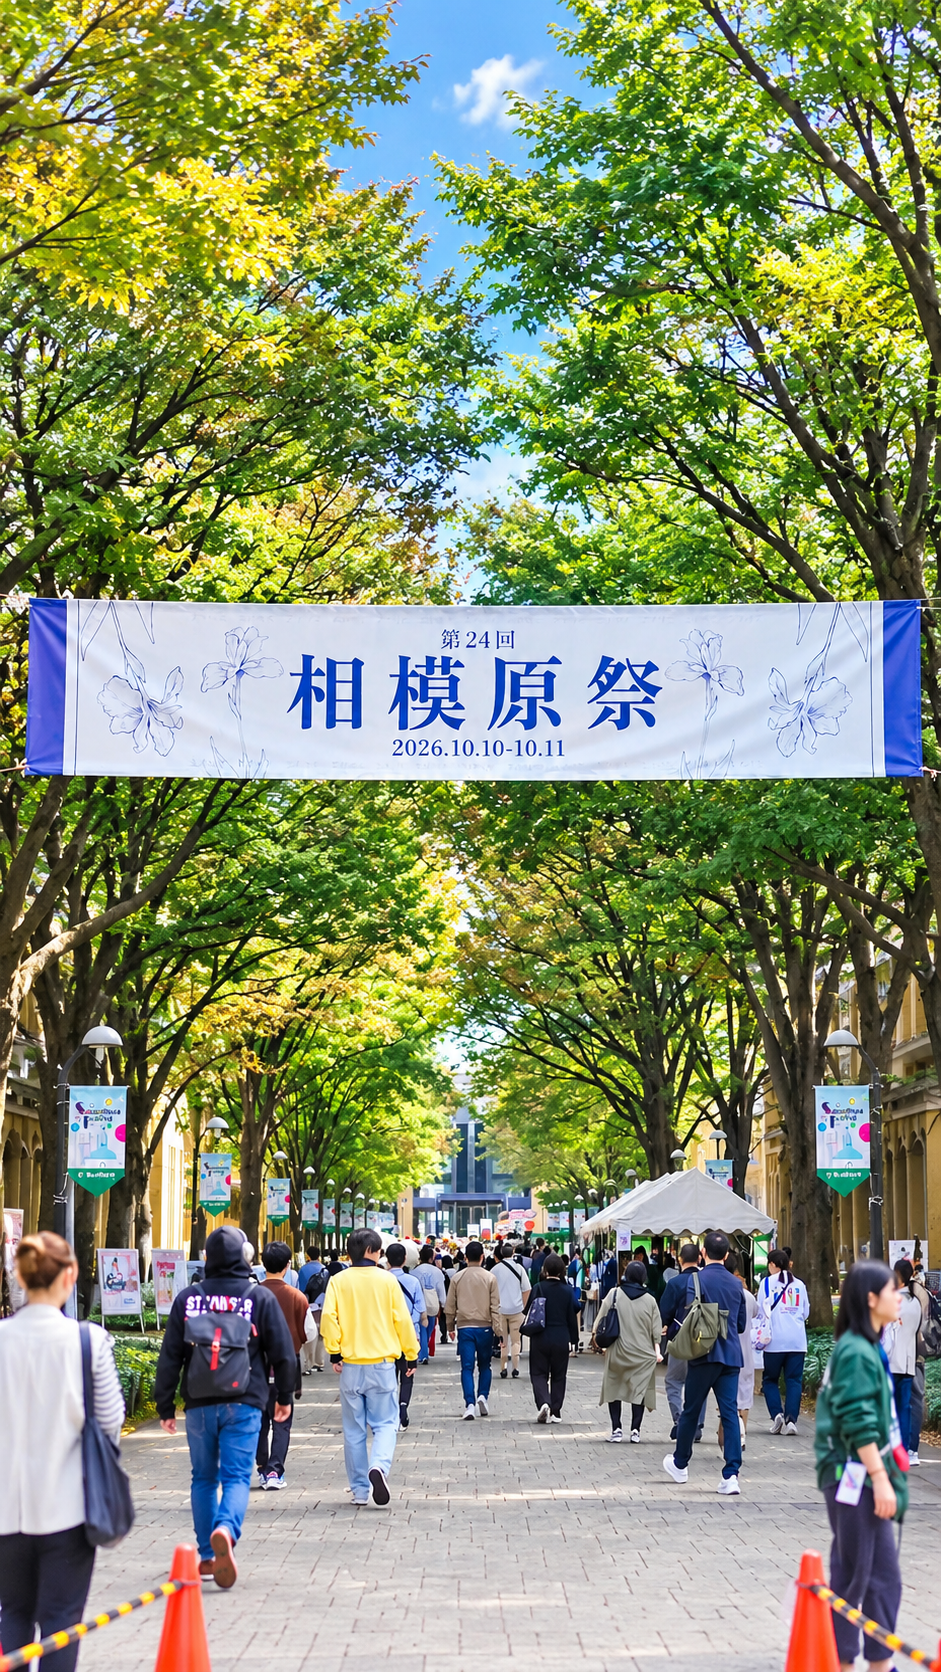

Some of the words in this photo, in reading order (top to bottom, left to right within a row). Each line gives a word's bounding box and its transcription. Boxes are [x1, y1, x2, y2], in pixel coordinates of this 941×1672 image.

[287, 654, 663, 731] 相模原祭
[392, 739, 564, 757] 2026.10.10-10.11
